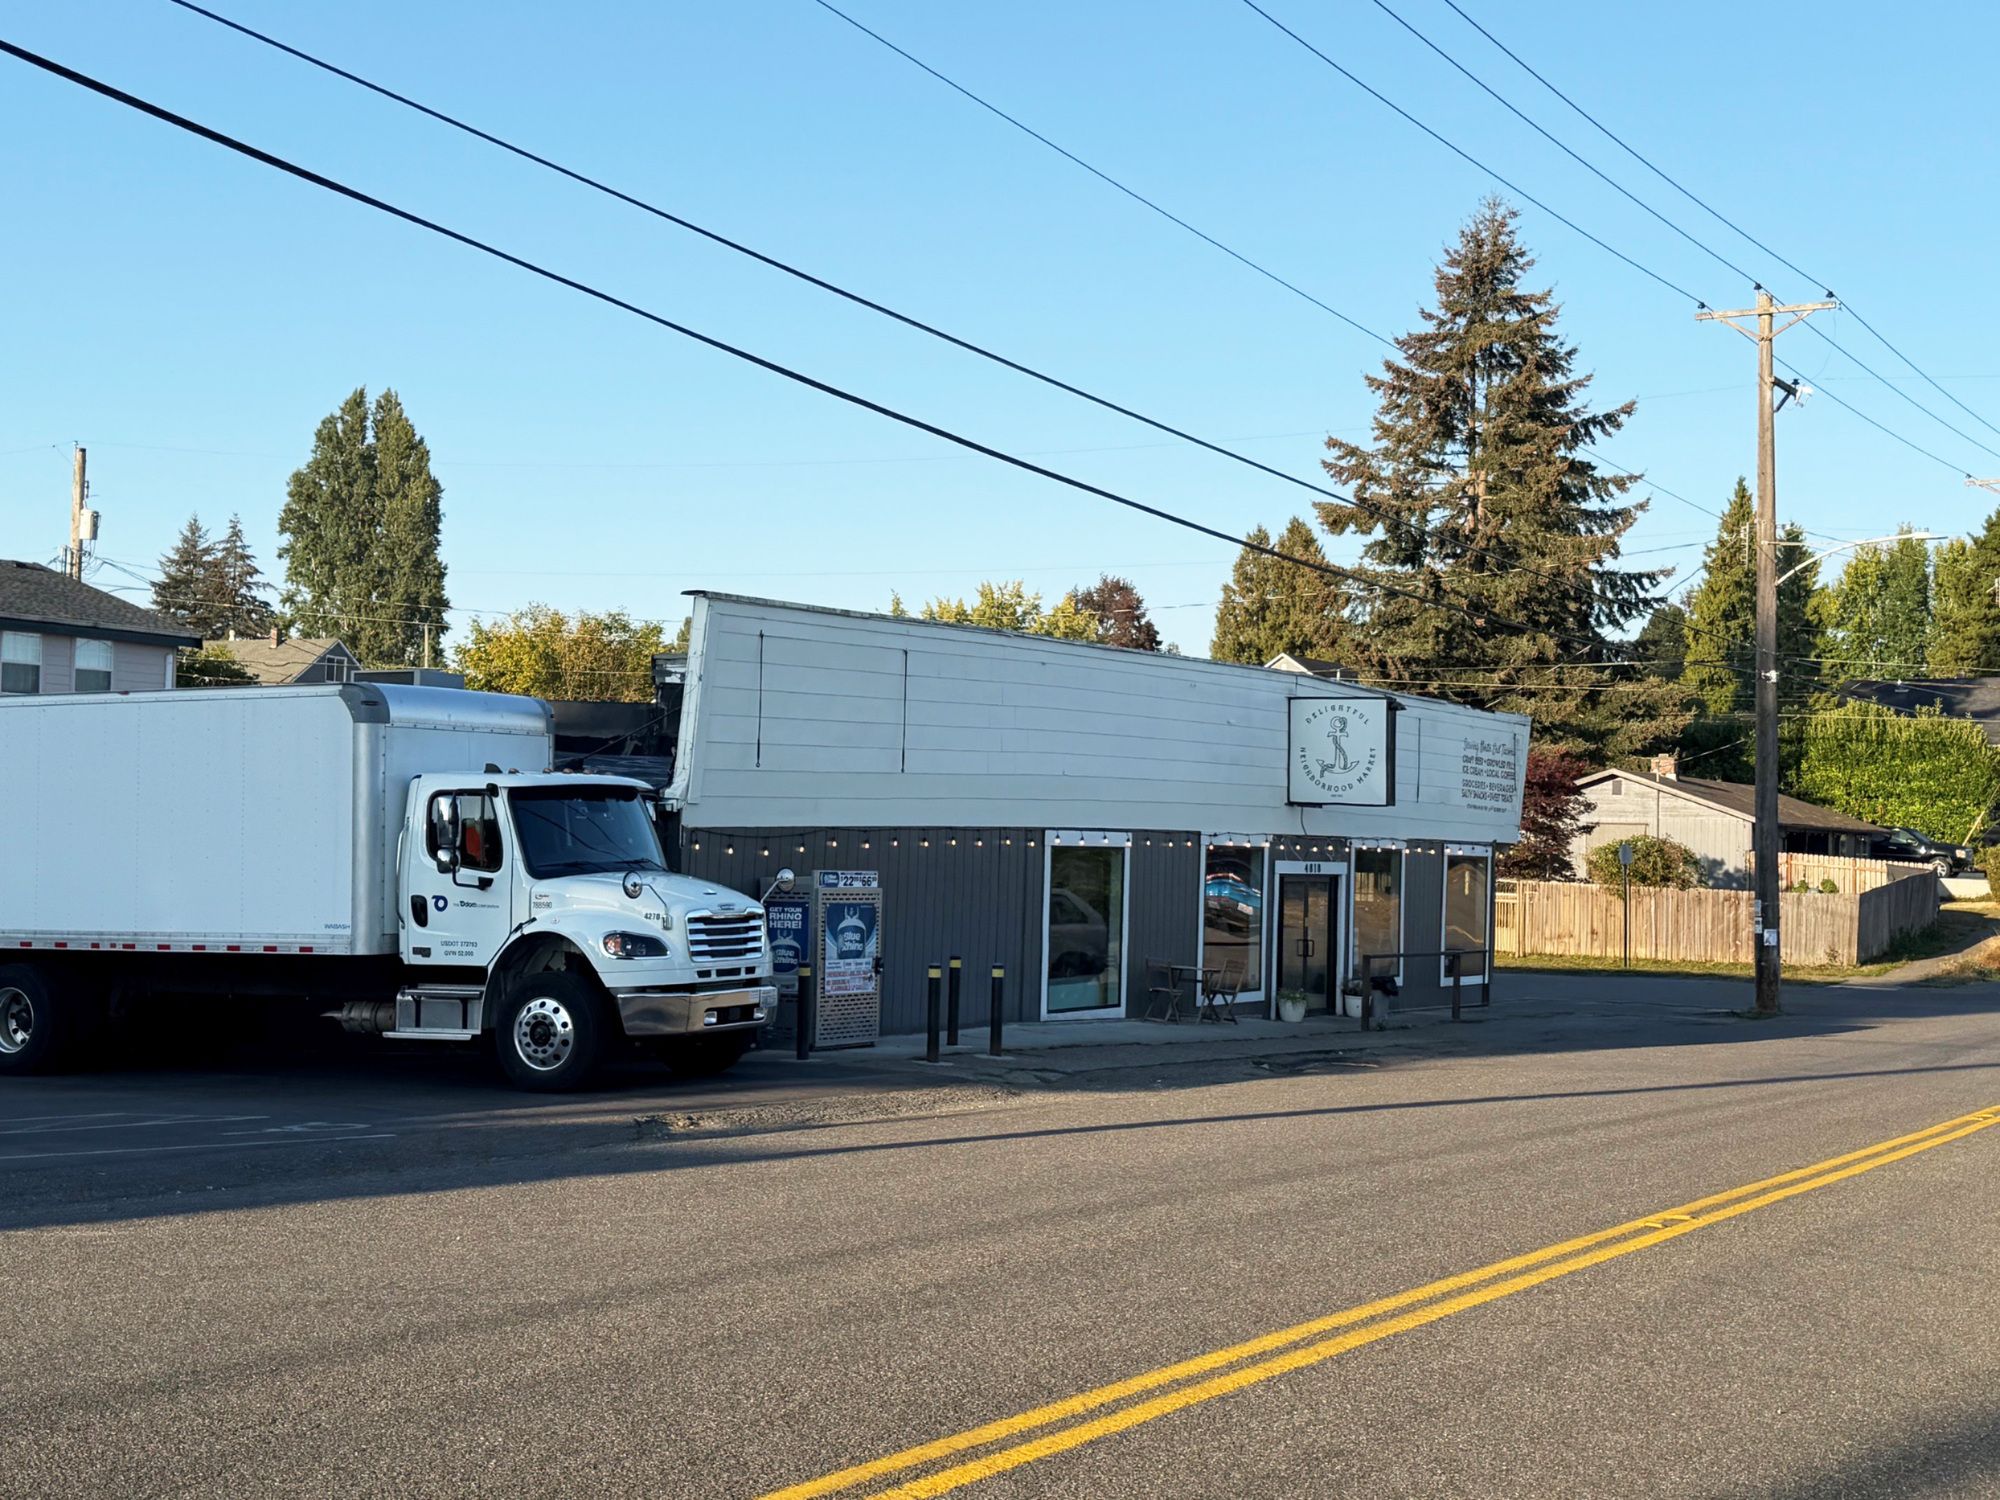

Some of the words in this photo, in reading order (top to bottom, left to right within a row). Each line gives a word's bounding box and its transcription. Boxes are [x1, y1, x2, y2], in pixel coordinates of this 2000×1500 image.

[1305, 704, 1370, 725] DELIGHTFUL
[1300, 747, 1354, 792] NEIGHBORHOOD
[1356, 747, 1376, 784] MARKET
[769, 912, 802, 920] RHINO
[769, 920, 802, 929] HERE!
